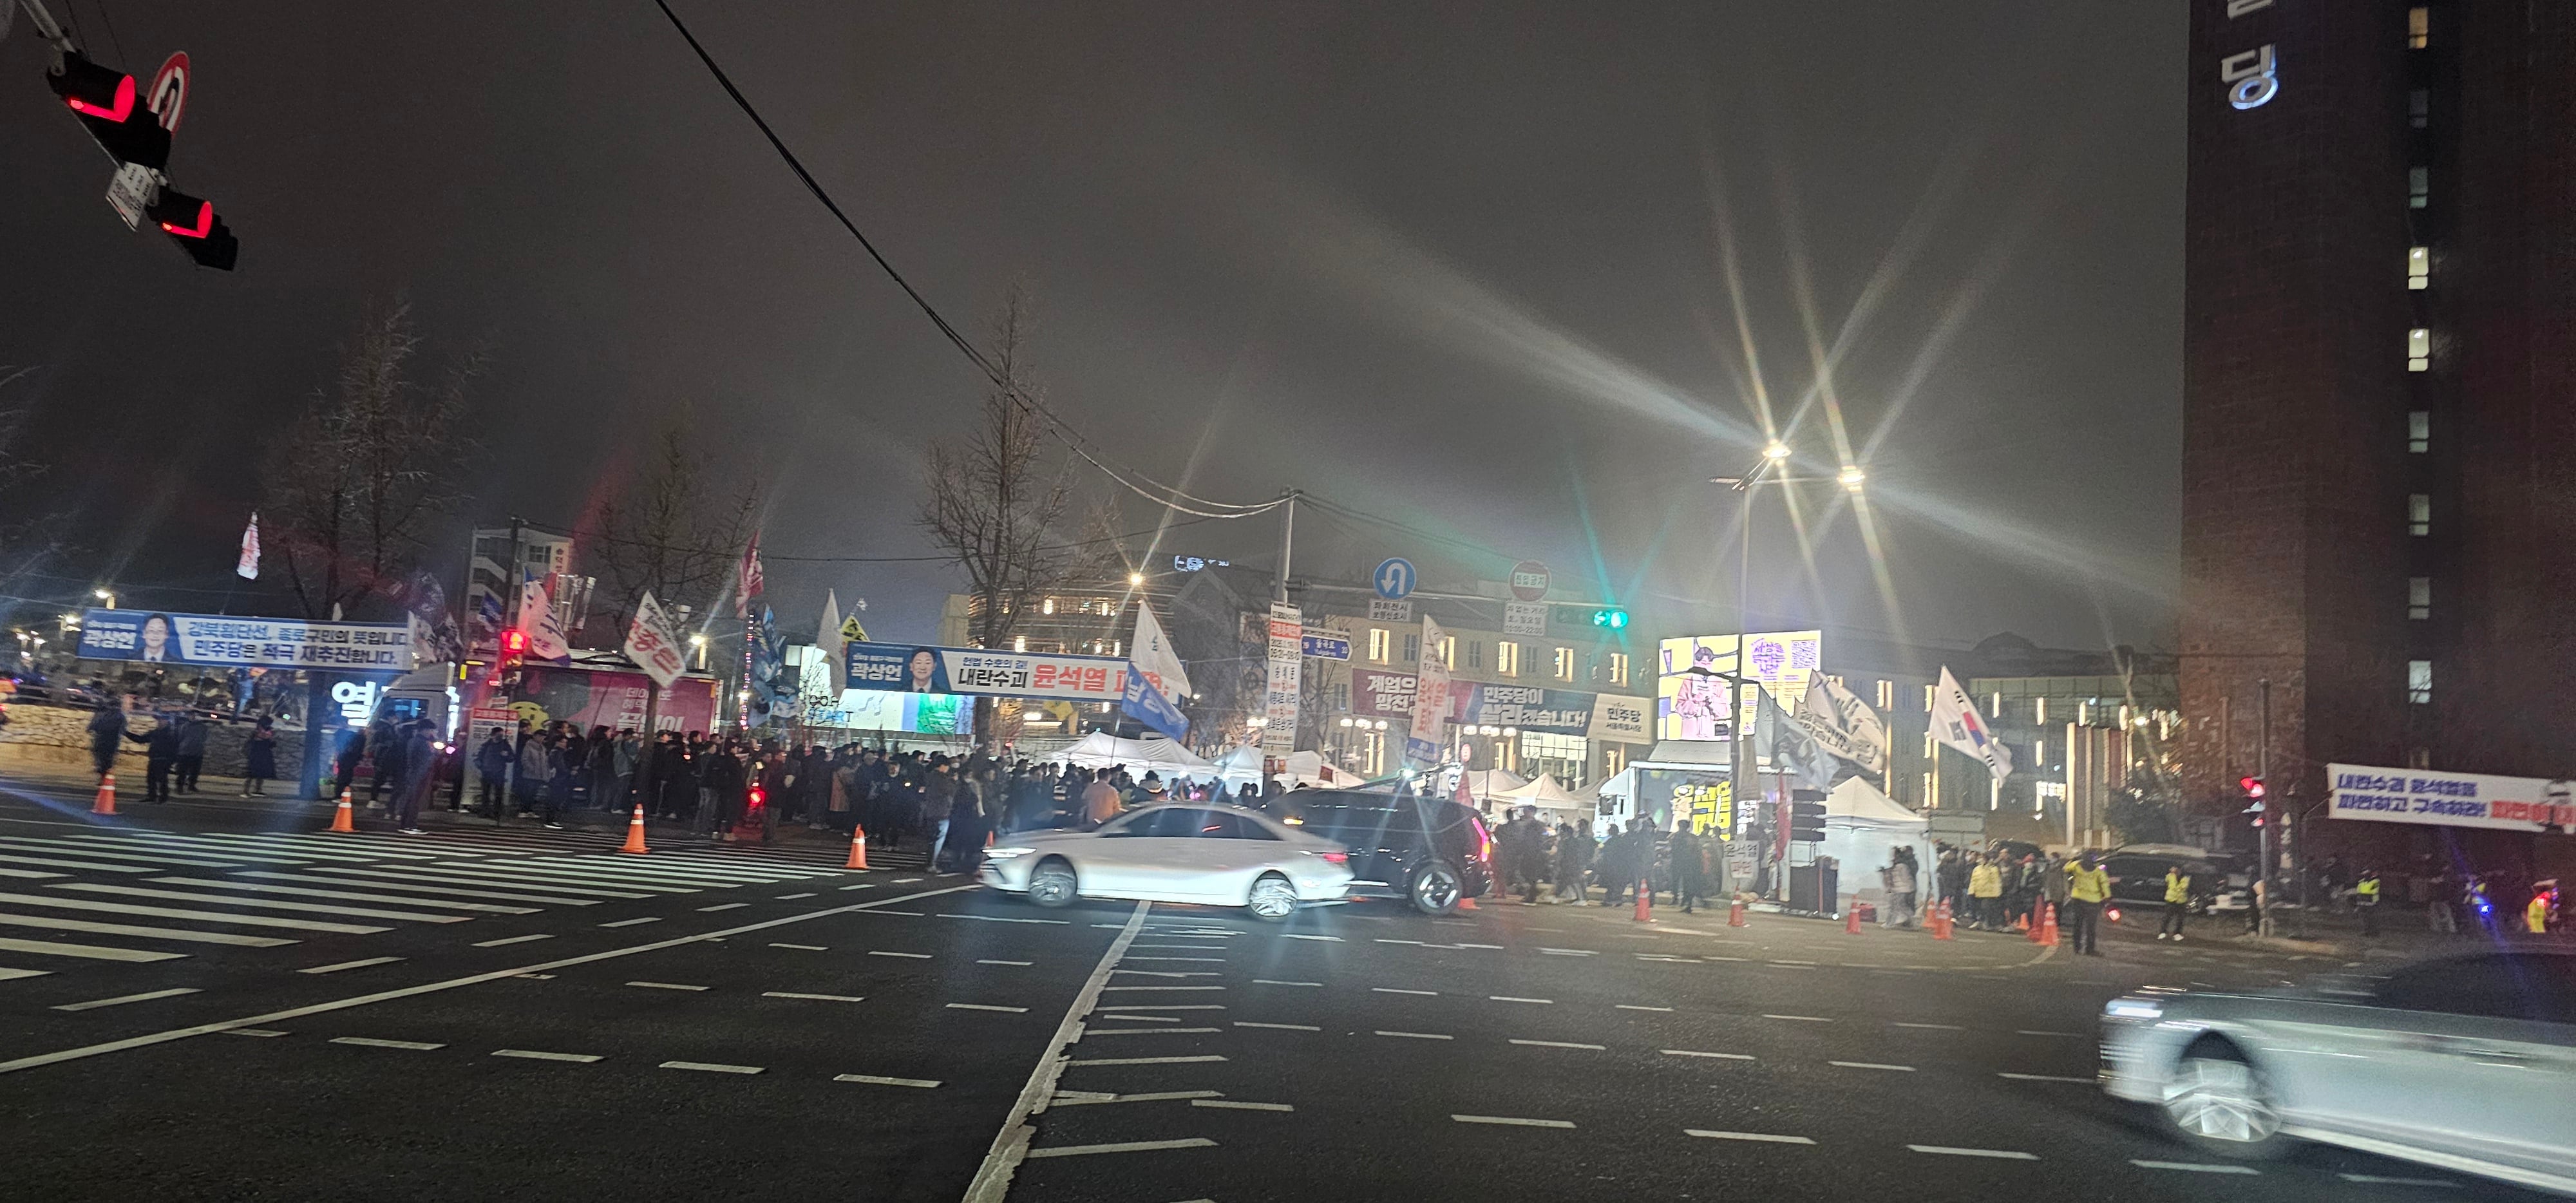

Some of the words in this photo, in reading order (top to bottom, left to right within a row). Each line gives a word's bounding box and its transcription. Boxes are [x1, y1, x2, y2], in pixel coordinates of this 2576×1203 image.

[851, 663, 903, 682] 곽상언
[958, 668, 1028, 688] 내란수괴
[1033, 664, 1107, 692] 윤석열
[1367, 675, 1417, 695] 계엄으
[1484, 687, 1544, 705] 민주당이
[1478, 704, 1587, 728] 살리겠습니다!
[1607, 708, 1642, 723] 민주당
